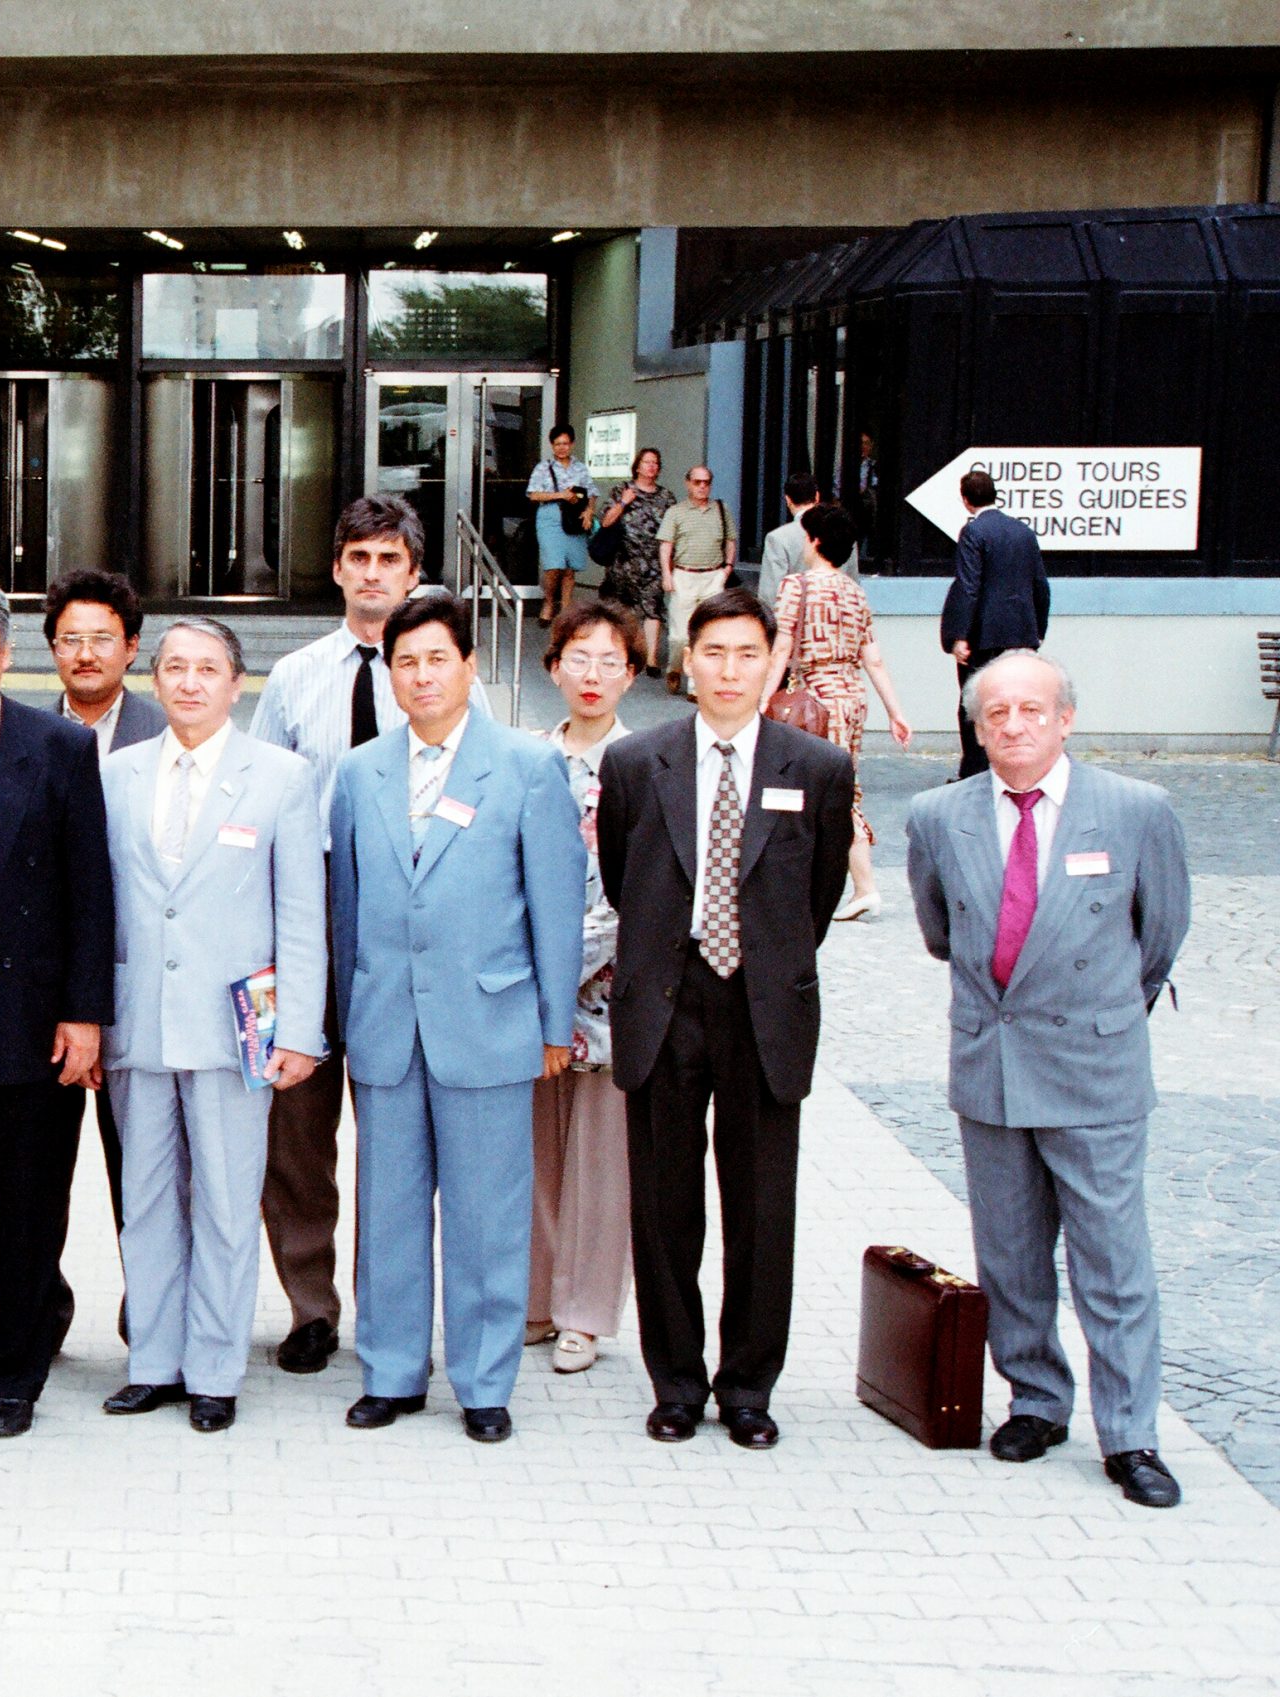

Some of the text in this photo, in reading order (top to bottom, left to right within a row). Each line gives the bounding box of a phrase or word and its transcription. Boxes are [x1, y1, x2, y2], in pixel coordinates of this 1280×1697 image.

[1077, 462, 1160, 481] TOURS
[996, 484, 1187, 509] SITES GUIDÉES
